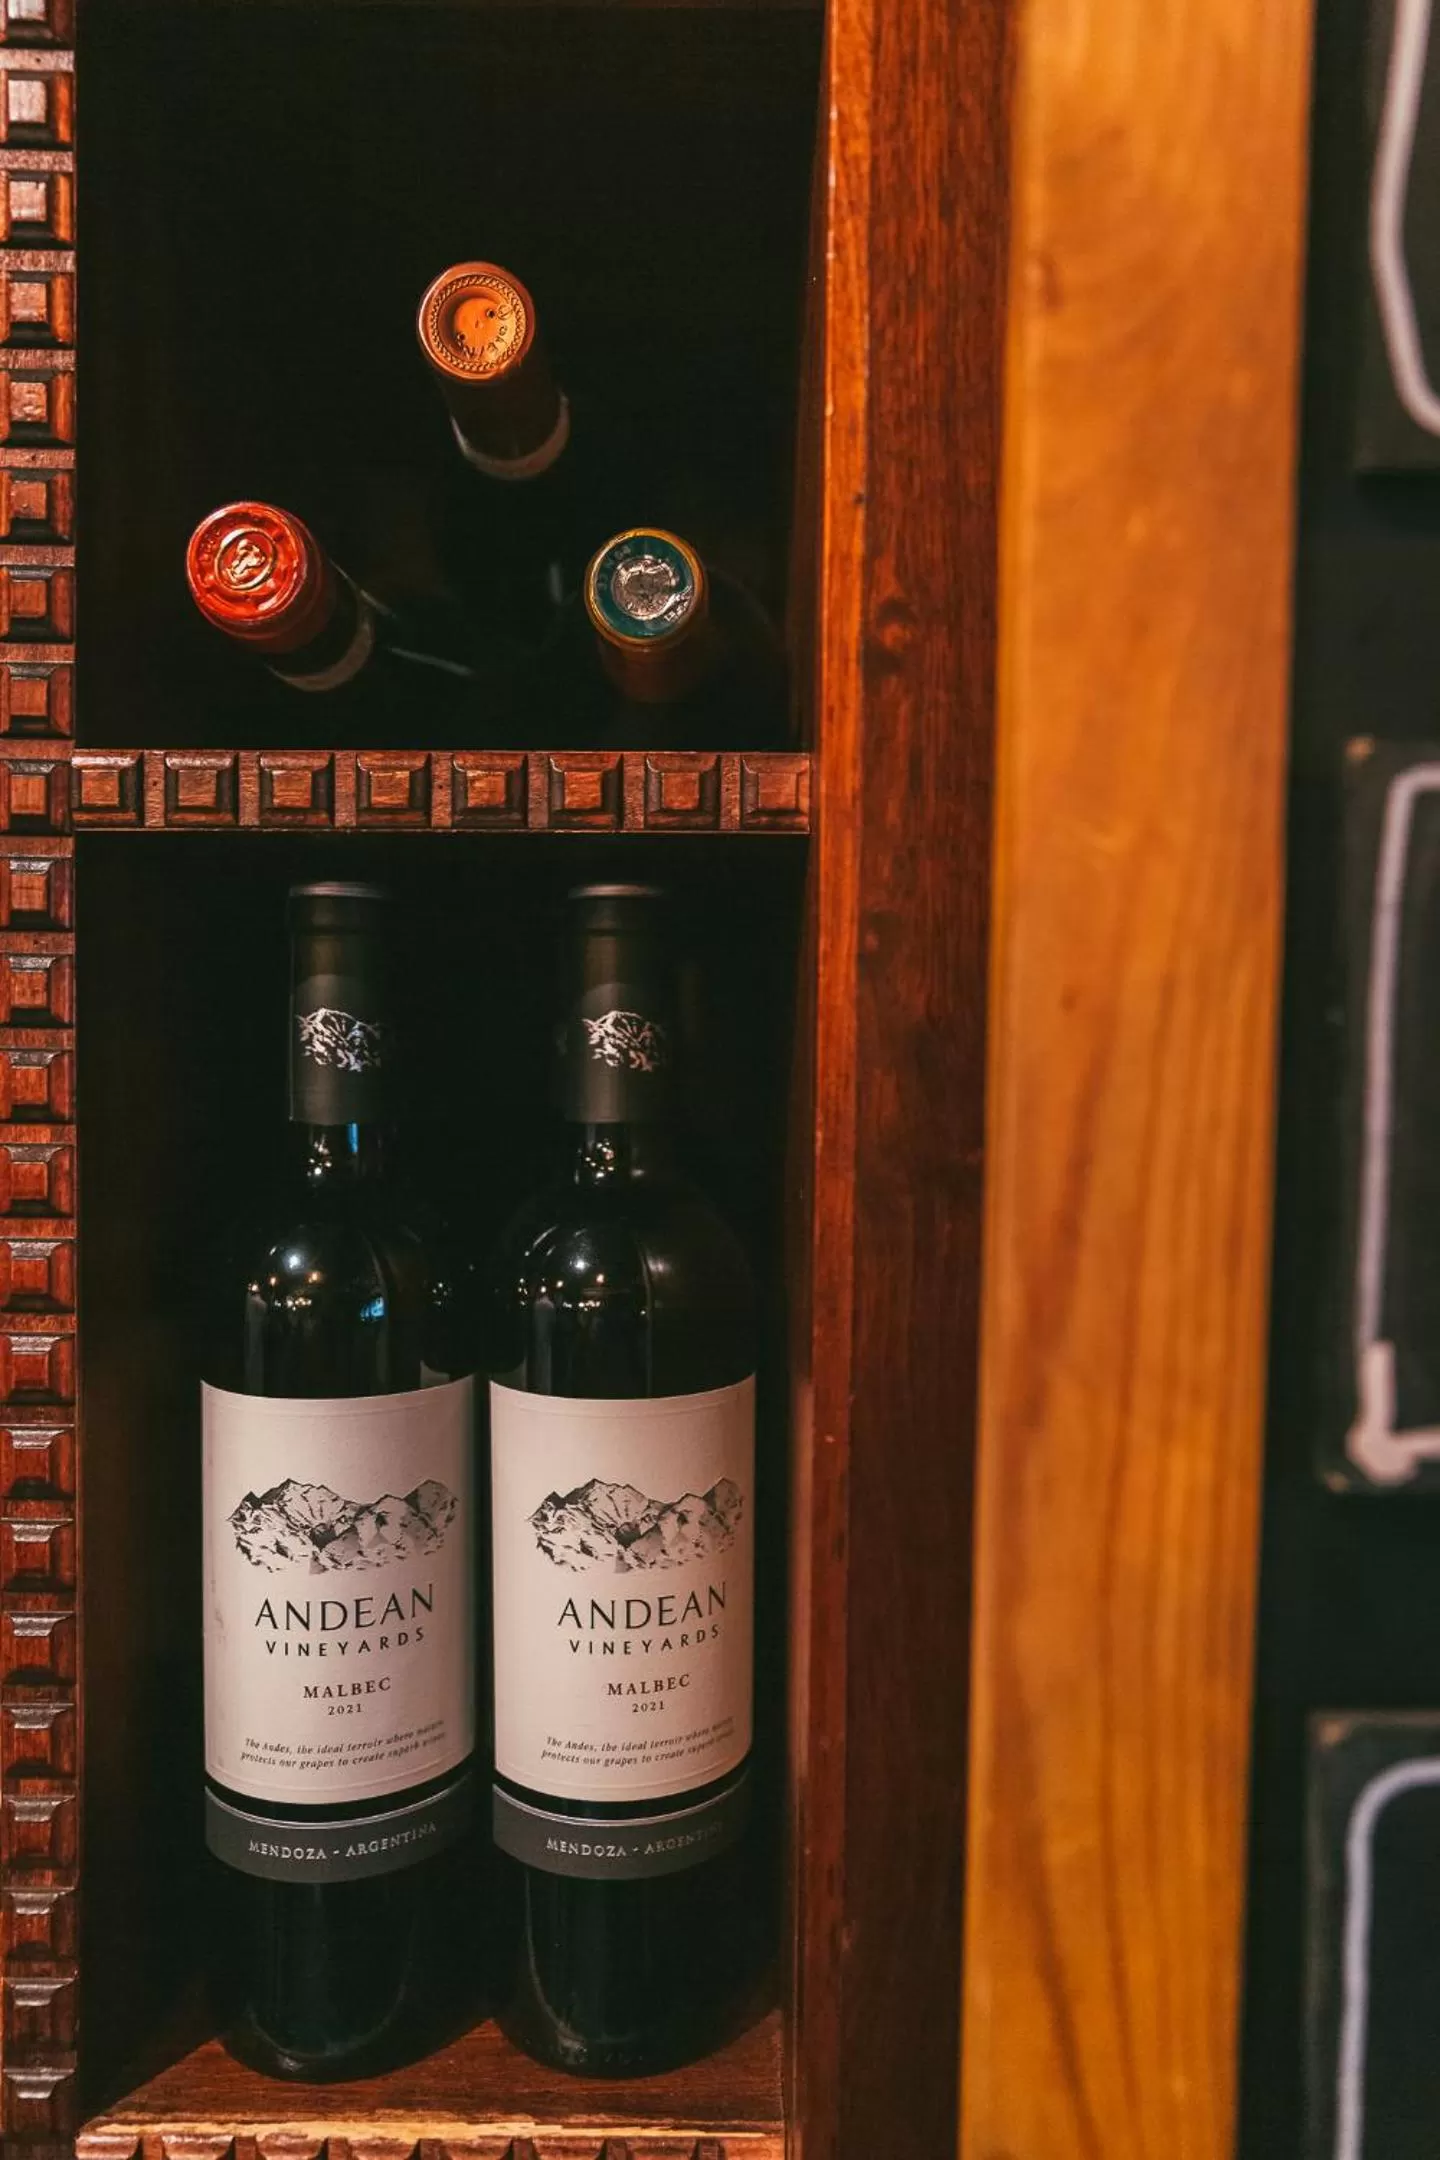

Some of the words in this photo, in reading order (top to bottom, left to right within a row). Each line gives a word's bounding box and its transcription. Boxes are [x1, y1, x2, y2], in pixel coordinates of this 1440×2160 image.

[255, 1583, 434, 1631] ANDEAN
[557, 1582, 727, 1629] ANDEAN
[266, 1627, 425, 1656] VINEYARDS
[569, 1625, 721, 1655] VINEYARDS
[303, 1677, 391, 1699] MALBEC
[608, 1674, 691, 1696] MALBEC
[327, 1703, 363, 1716] 2021
[632, 1701, 665, 1713] 2021
[245, 1738, 260, 1749] The
[297, 1745, 313, 1754] the
[317, 1744, 344, 1754] ideal
[347, 1738, 383, 1752] terroir
[547, 1736, 562, 1747] The
[565, 1740, 597, 1752] Andes,
[601, 1742, 617, 1752] the
[621, 1740, 648, 1751] ideal
[650, 1736, 683, 1749] terroir
[241, 1752, 276, 1766] protects
[279, 1759, 297, 1768] our
[299, 1759, 335, 1770] grapes
[338, 1758, 349, 1767] to
[352, 1752, 385, 1765] create
[541, 1749, 580, 1763] protects
[583, 1757, 600, 1765] our
[603, 1757, 637, 1768] grapes
[642, 1755, 651, 1763] to
[654, 1749, 685, 1761] create
[249, 1841, 327, 1860] MENDOZA
[345, 1822, 437, 1858] ARGENTINA
[546, 1837, 627, 1857] MENDOZA
